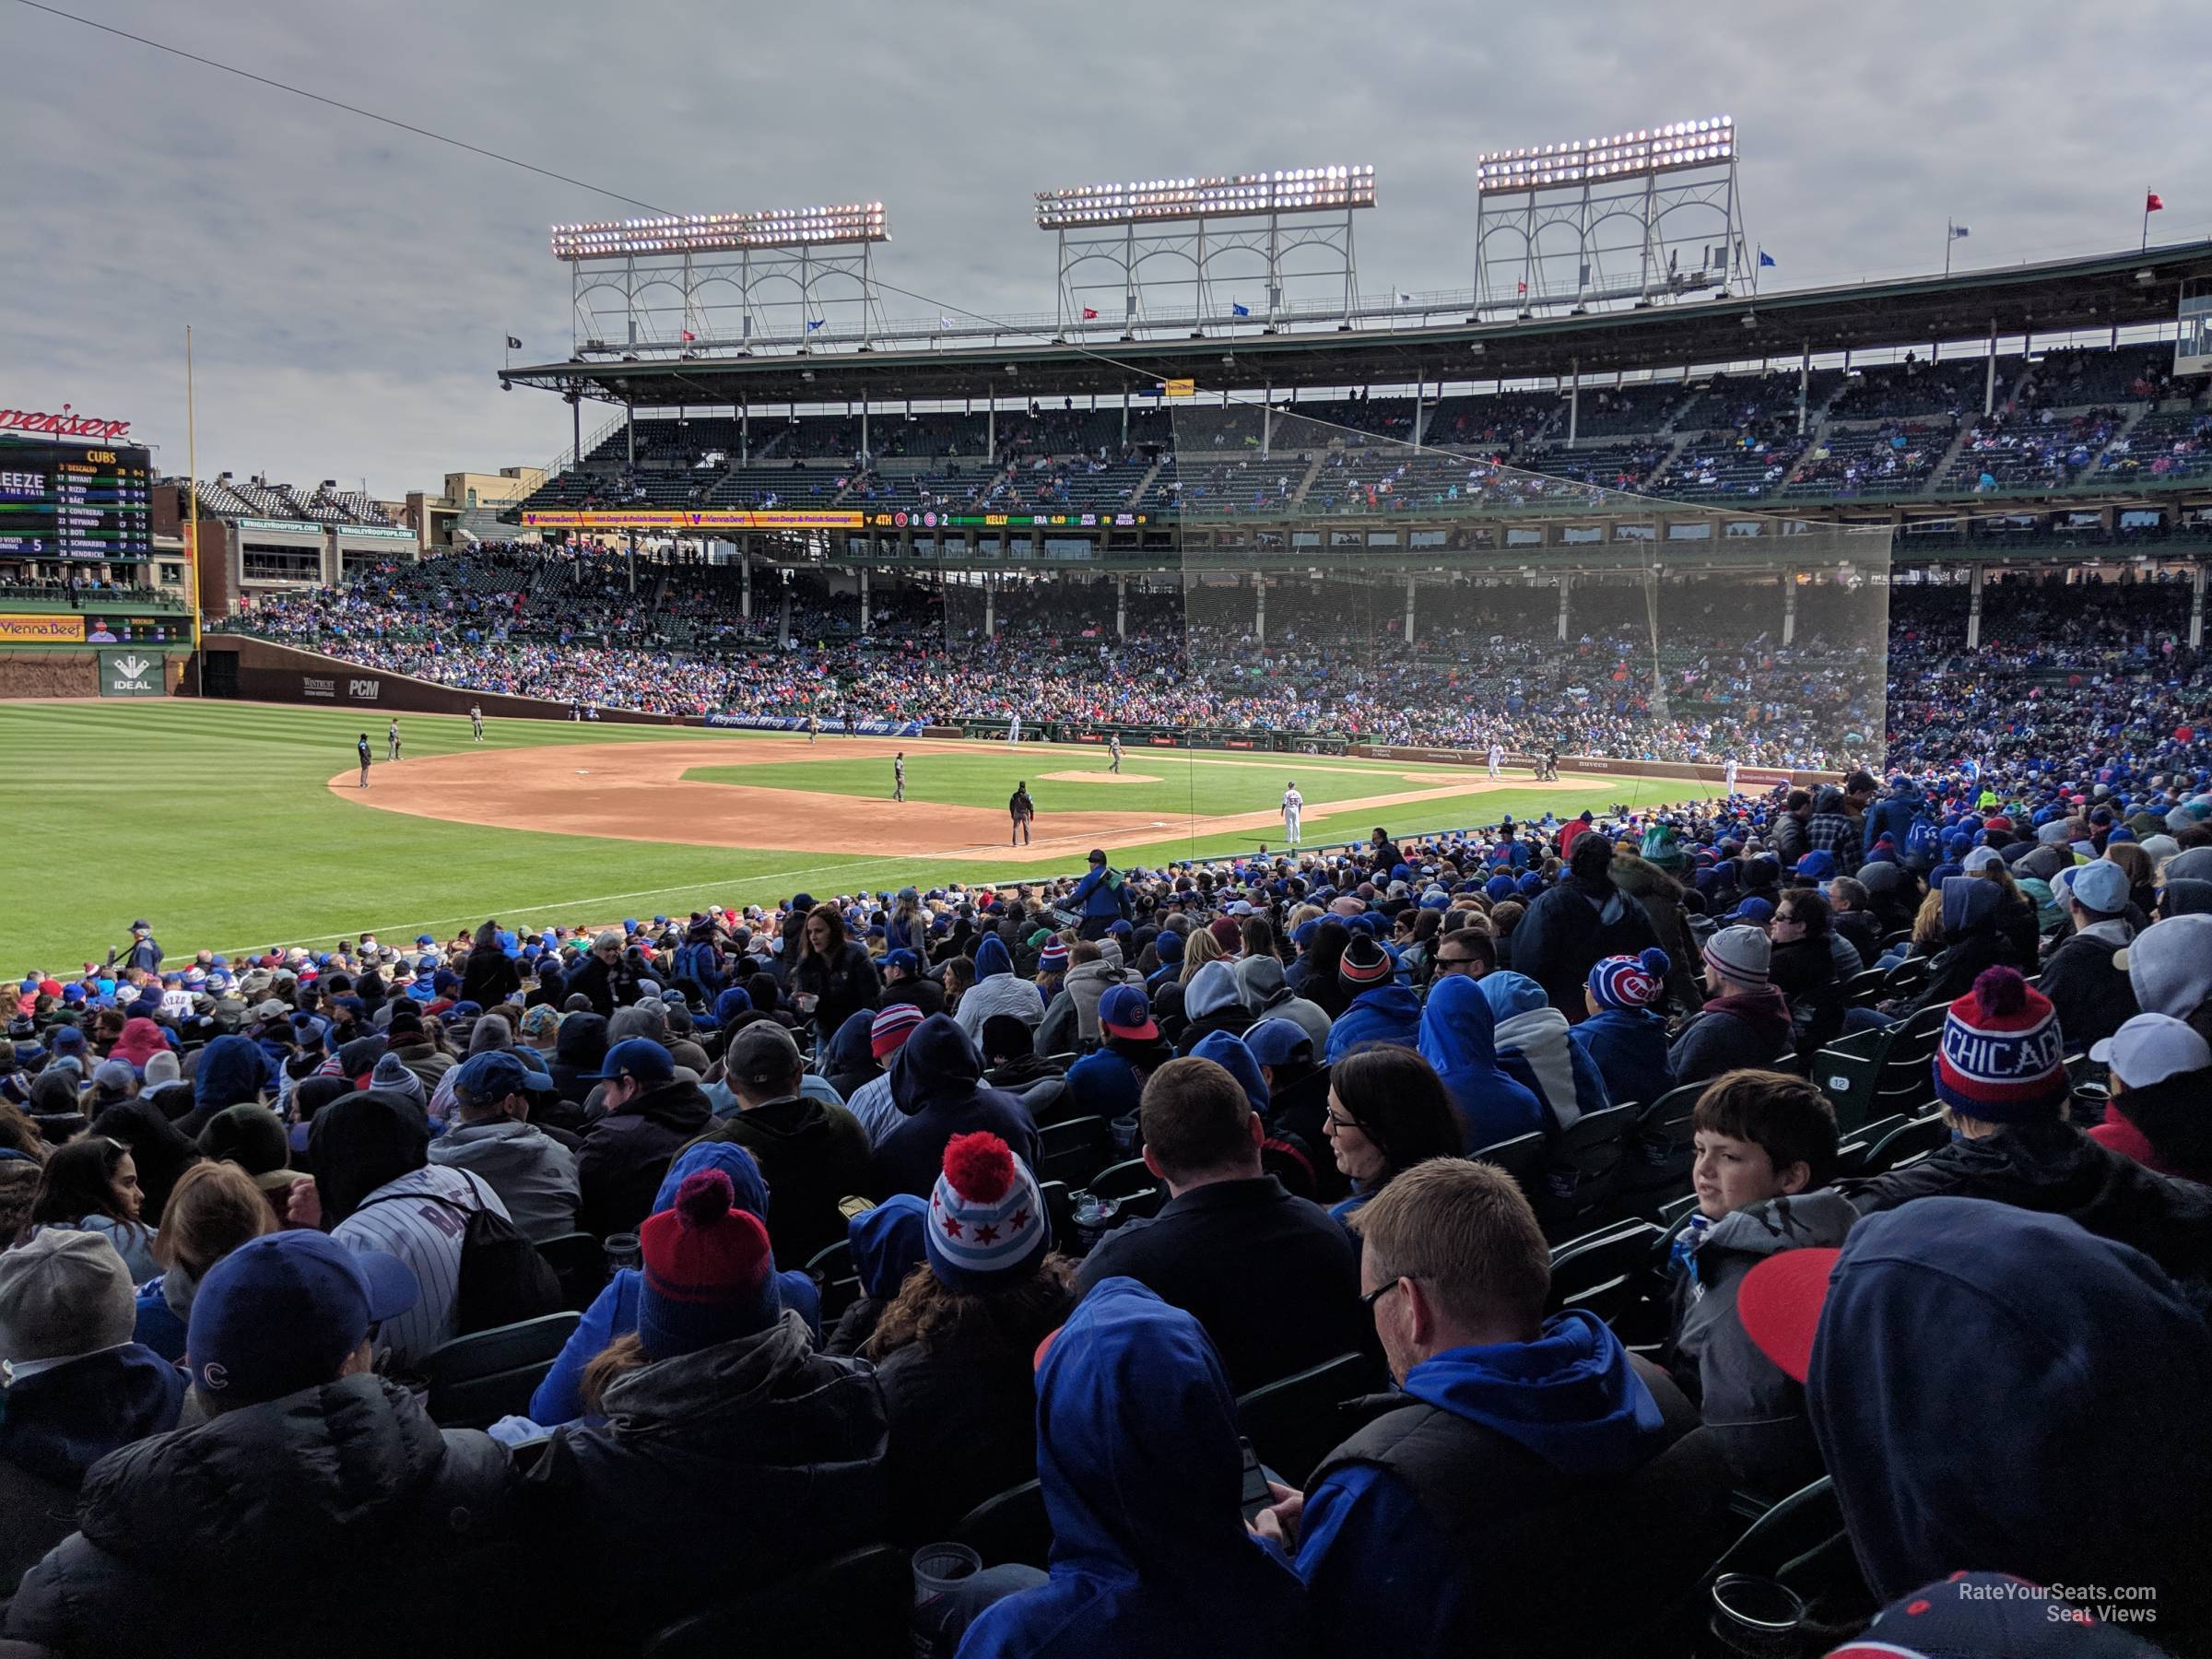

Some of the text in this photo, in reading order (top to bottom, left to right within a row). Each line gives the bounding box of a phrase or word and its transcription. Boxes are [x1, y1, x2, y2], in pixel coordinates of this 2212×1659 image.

[88, 450, 117, 464] CUBS
[0, 472, 44, 488] EEZE
[68, 476, 92, 484] BRYANT
[70, 518, 100, 526] HEYWARD
[876, 514, 892, 525] 4TH
[912, 514, 919, 525] 0
[942, 513, 948, 525] 2
[985, 515, 1008, 524] KELLY
[1034, 515, 1065, 524] ERA 4.09
[243, 520, 319, 532] WRIGLEYROOFTOPS.COM
[341, 526, 413, 538] WRIGLEYROOFTOPS.COM
[33, 539, 42, 552] 5
[70, 540, 107, 548] SCHWARBER
[71, 550, 105, 559] HENDRICKS
[0, 620, 81, 638] Vienna Beef
[114, 681, 151, 689] IDEAL
[349, 679, 380, 696] PCM
[711, 714, 758, 726] Reynolds
[758, 716, 786, 729] Wrap
[859, 721, 889, 734] Wrap
[1579, 760, 1608, 769] nuveen
[1835, 1078, 1845, 1088] 12
[205, 1361, 229, 1390] C
